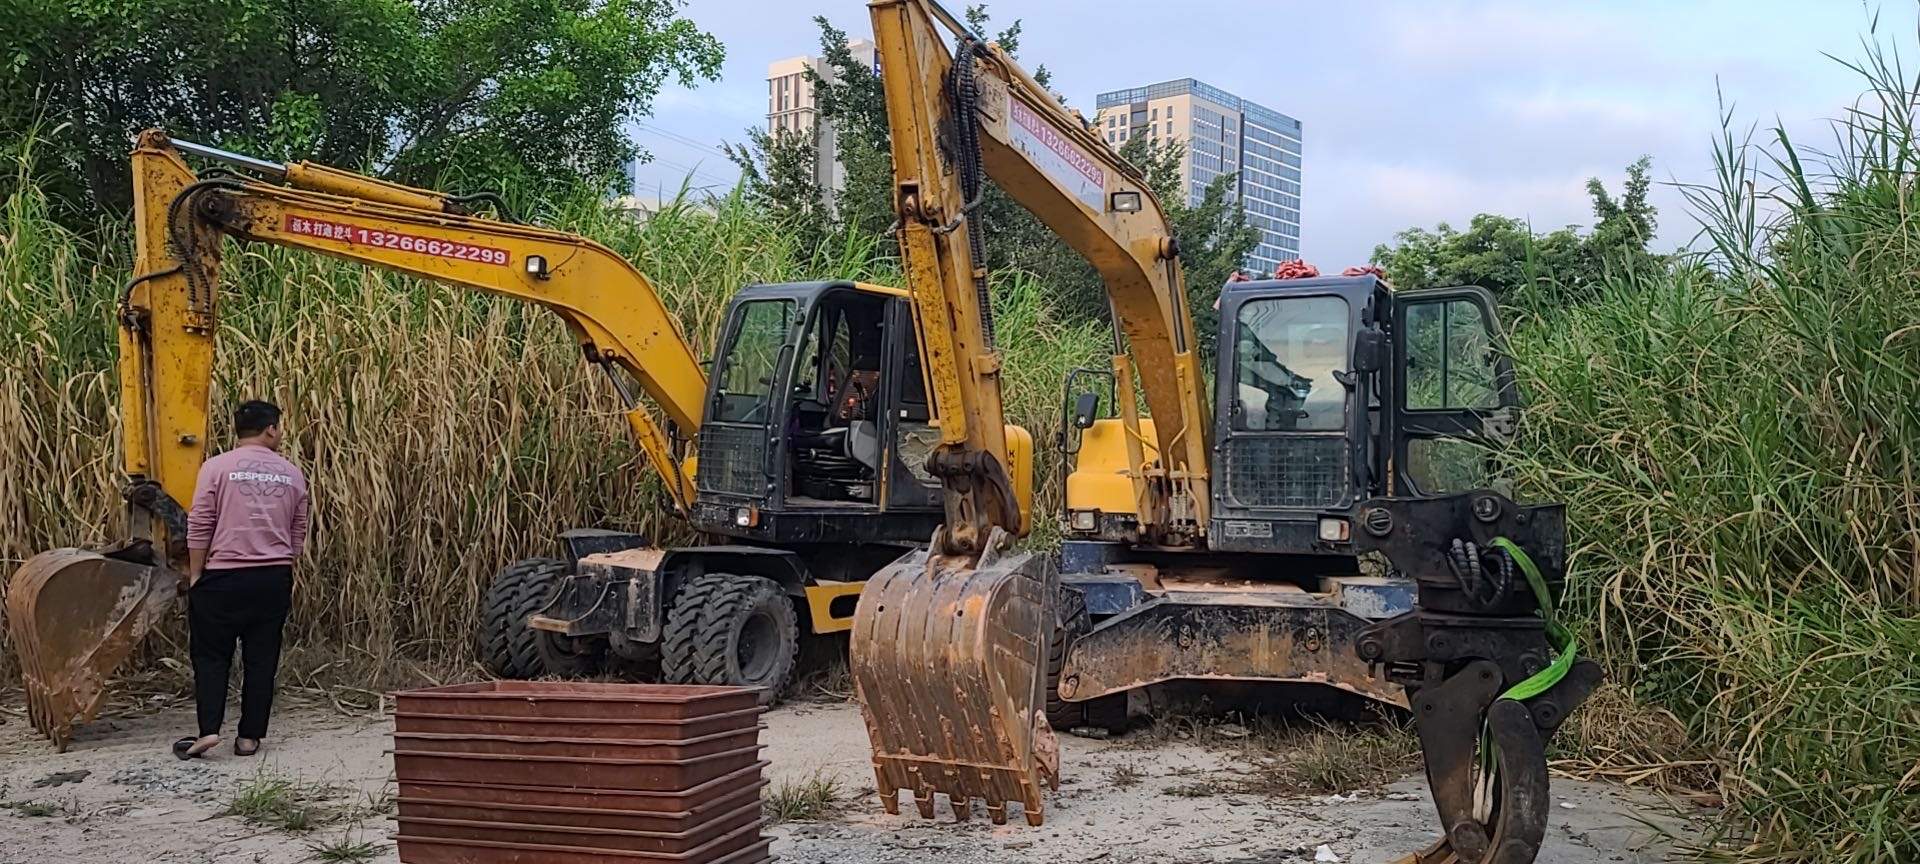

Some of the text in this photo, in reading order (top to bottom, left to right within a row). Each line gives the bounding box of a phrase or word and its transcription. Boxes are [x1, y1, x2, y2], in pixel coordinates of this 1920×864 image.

[1041, 126, 1102, 185] 13266622299
[358, 229, 506, 264] 13266622299
[229, 471, 292, 485] DESPERATE
